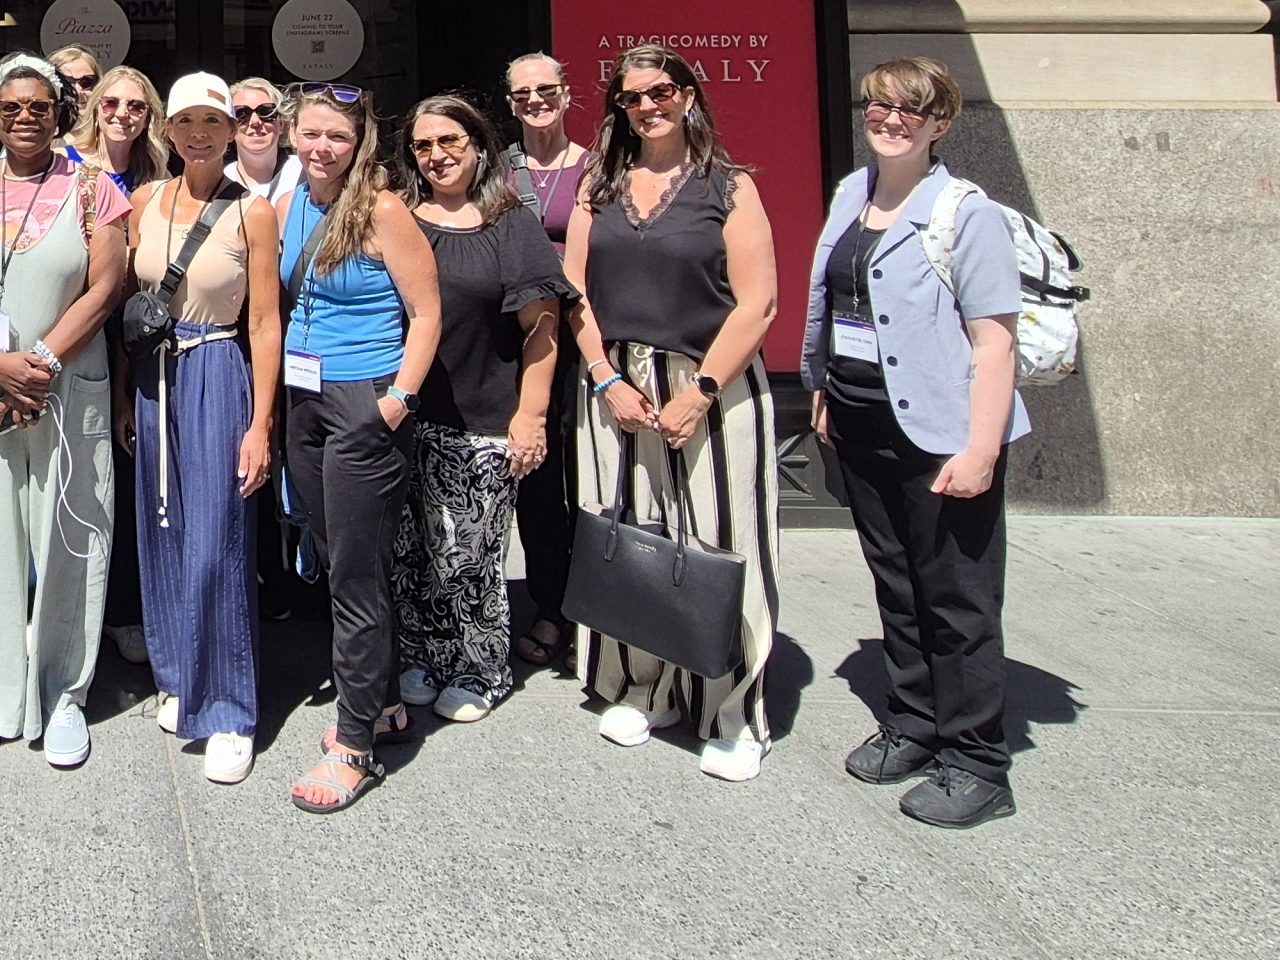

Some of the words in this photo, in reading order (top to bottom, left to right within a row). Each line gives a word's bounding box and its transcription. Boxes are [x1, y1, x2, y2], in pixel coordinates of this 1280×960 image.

[55, 17, 113, 35] Piazza
[598, 35, 610, 48] A
[617, 35, 741, 48] TRAGICOMEDY
[750, 35, 768, 48] BY
[598, 59, 771, 82] EALY
